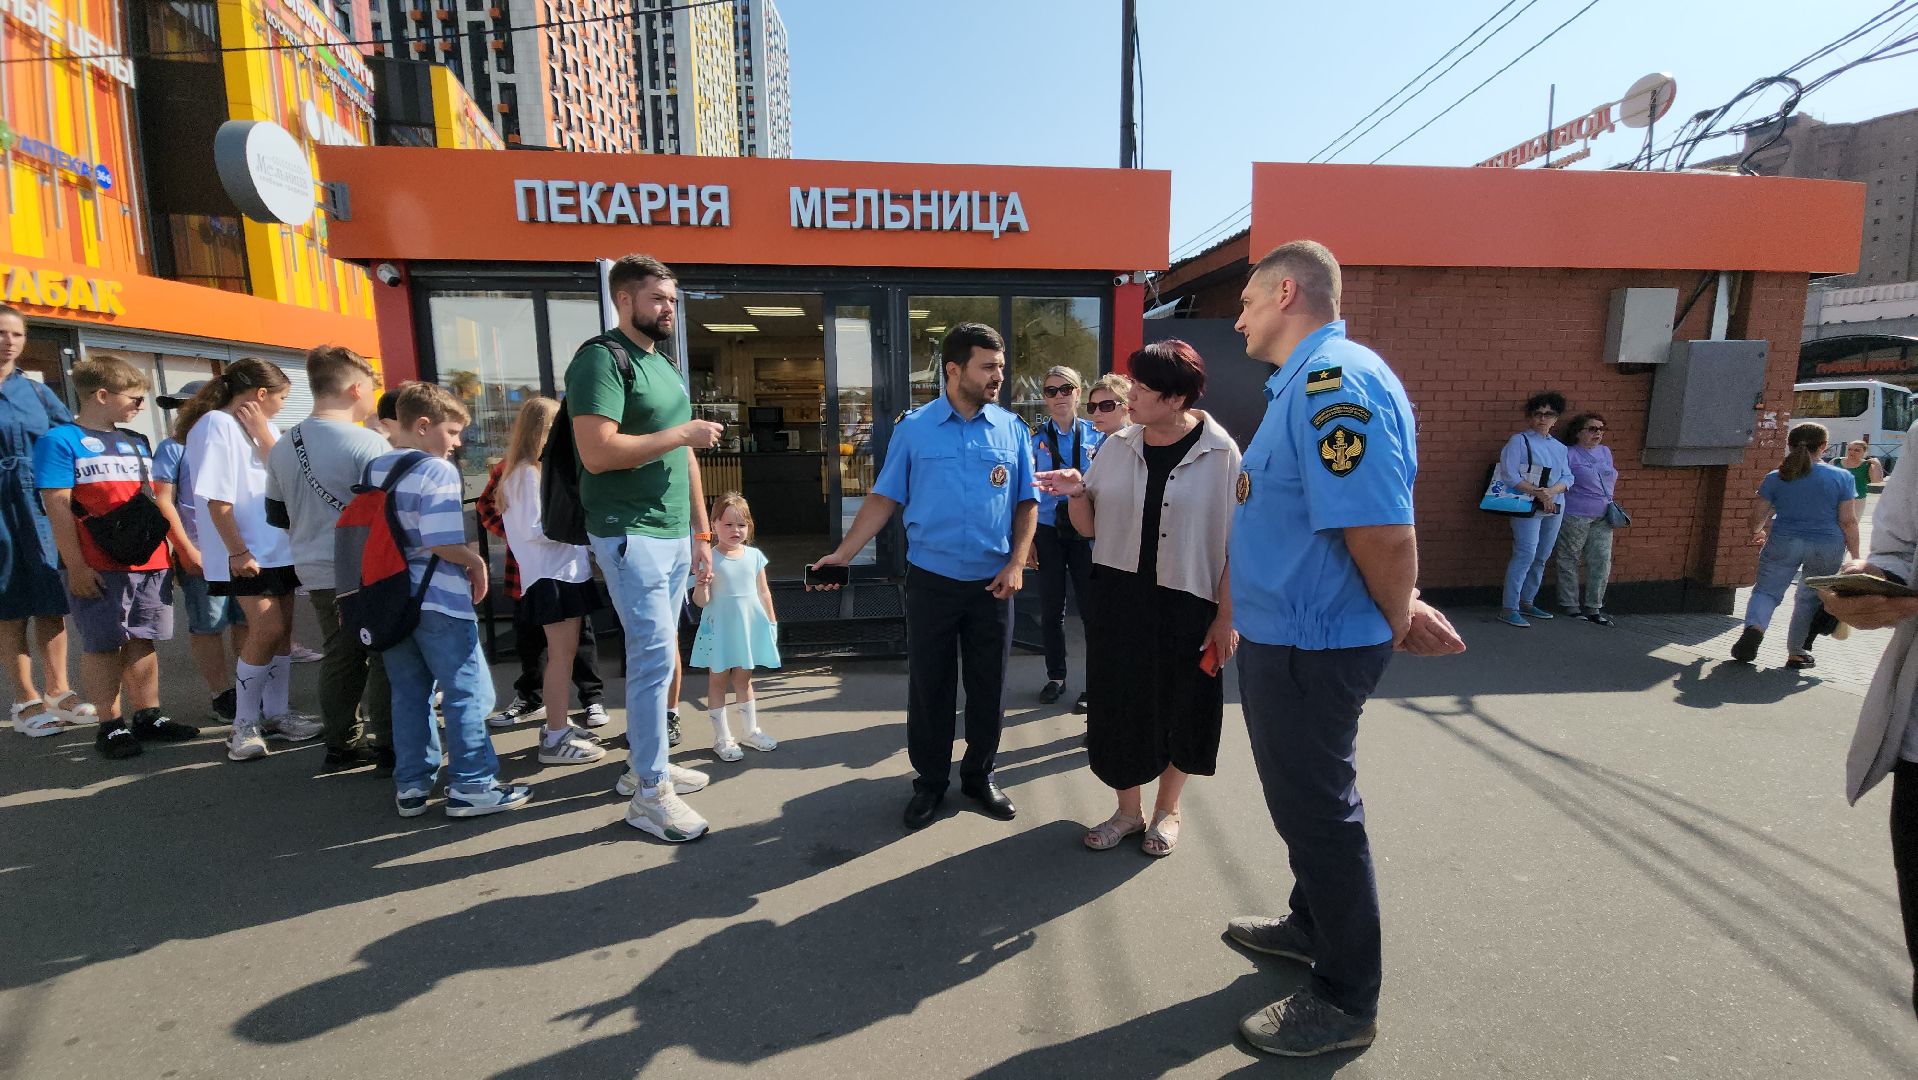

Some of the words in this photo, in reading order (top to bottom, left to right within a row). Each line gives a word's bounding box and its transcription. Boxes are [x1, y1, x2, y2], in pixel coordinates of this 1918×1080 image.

[67, 20, 136, 89] ЦЕНЫ
[265, 8, 311, 60] КОСМЕТИКА
[20, 136, 92, 178] АПТЕКА
[514, 179, 731, 227] ПЕКАРНЯ
[789, 185, 1029, 239] МЕЛЬНИЦА
[74, 463, 110, 479] BUILT
